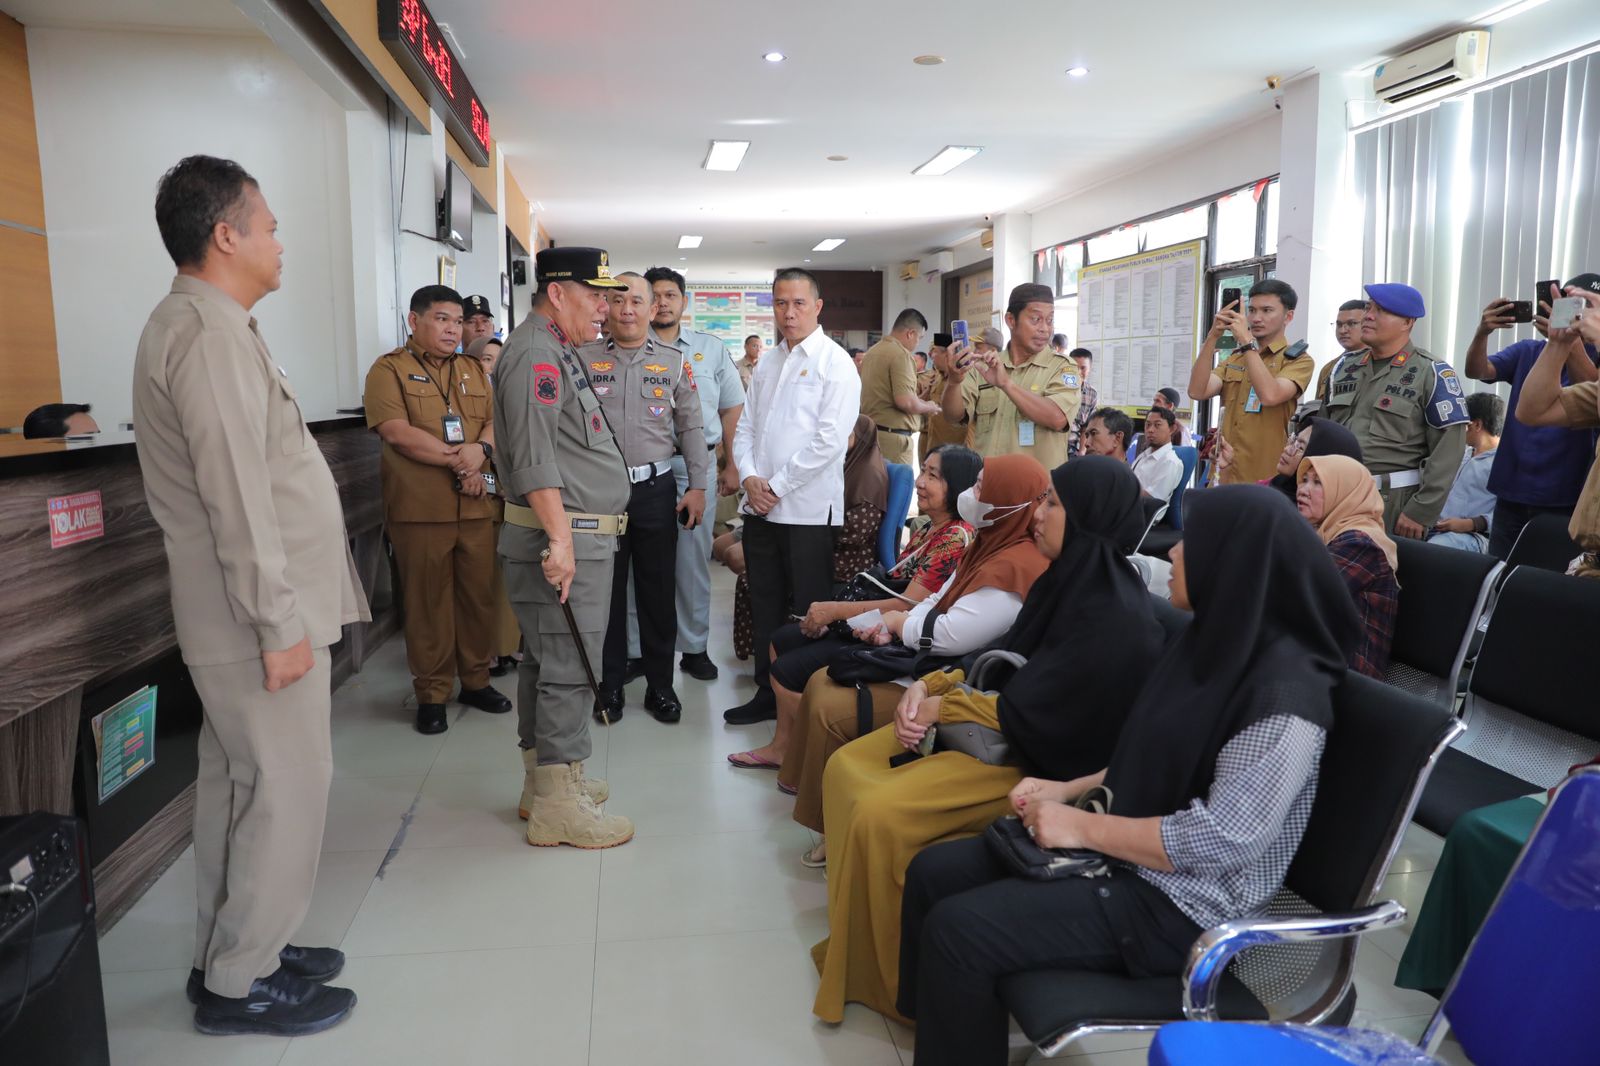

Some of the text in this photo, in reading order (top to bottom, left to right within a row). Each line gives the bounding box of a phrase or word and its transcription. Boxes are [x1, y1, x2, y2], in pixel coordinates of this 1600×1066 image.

[593, 374, 616, 383] IDRA
[643, 376, 671, 386] POLRI
[1385, 384, 1416, 399] POL PP
[52, 508, 87, 535] TOLAK
